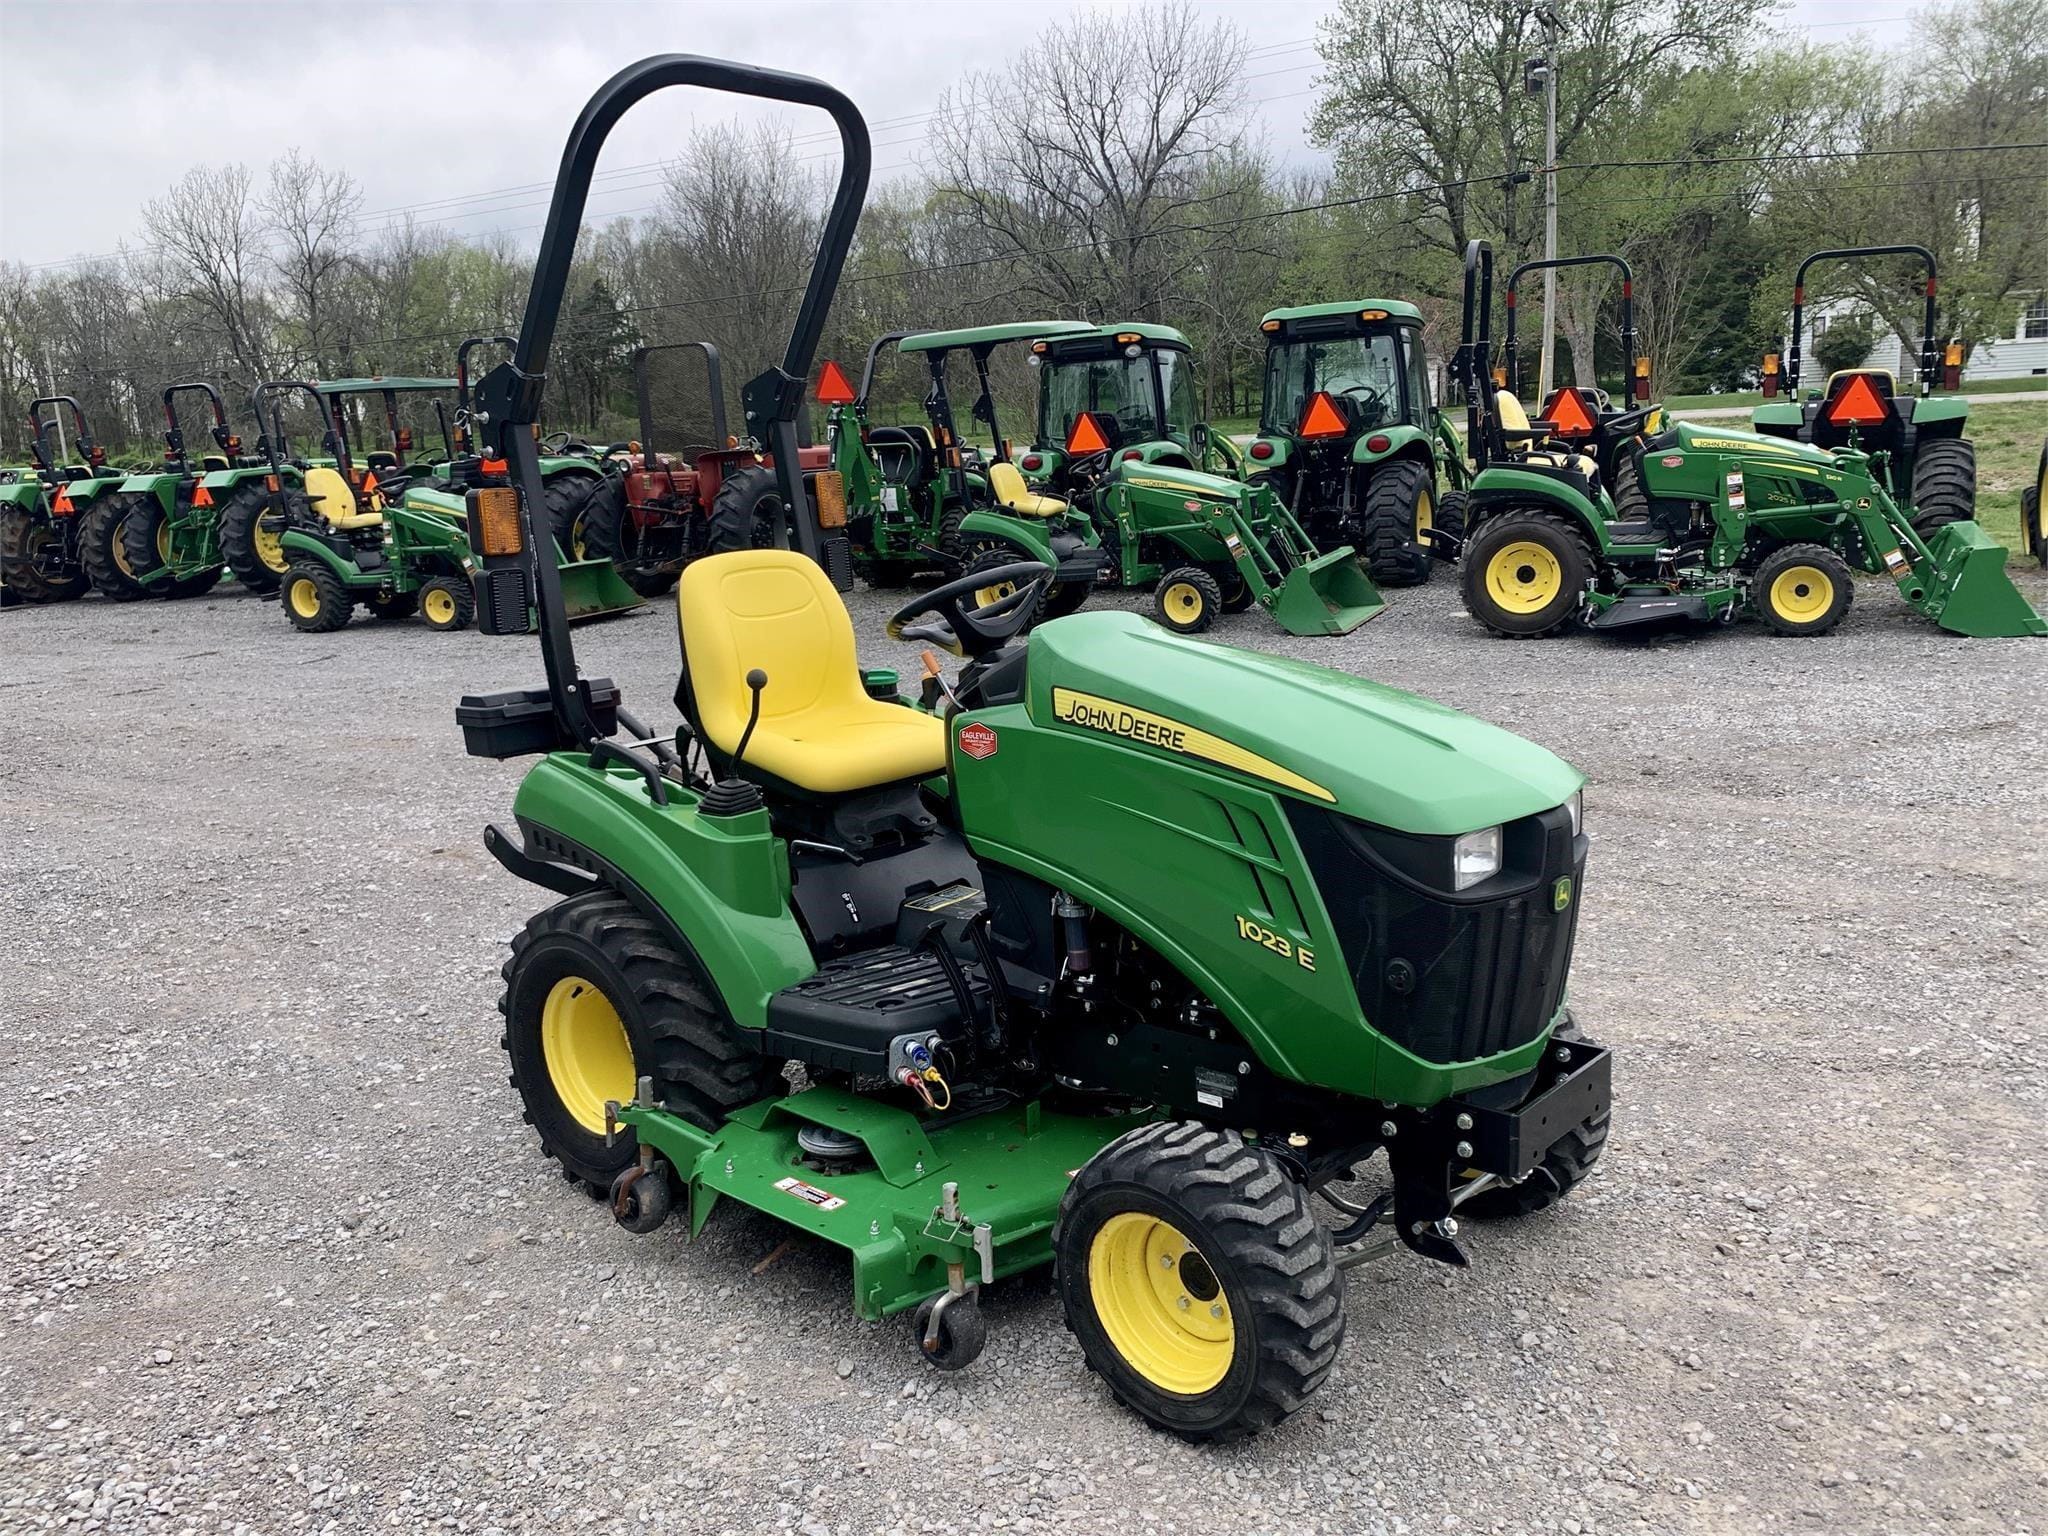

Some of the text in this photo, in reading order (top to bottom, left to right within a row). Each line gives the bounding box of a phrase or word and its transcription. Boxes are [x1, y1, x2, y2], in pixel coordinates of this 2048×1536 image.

[1721, 441, 1748, 449] DEERE
[1767, 493, 1789, 504] 2025
[1064, 699, 1186, 750] JOHN DEERE
[961, 731, 995, 741] EAGLEVILLE
[1235, 914, 1317, 972] 1023 E
